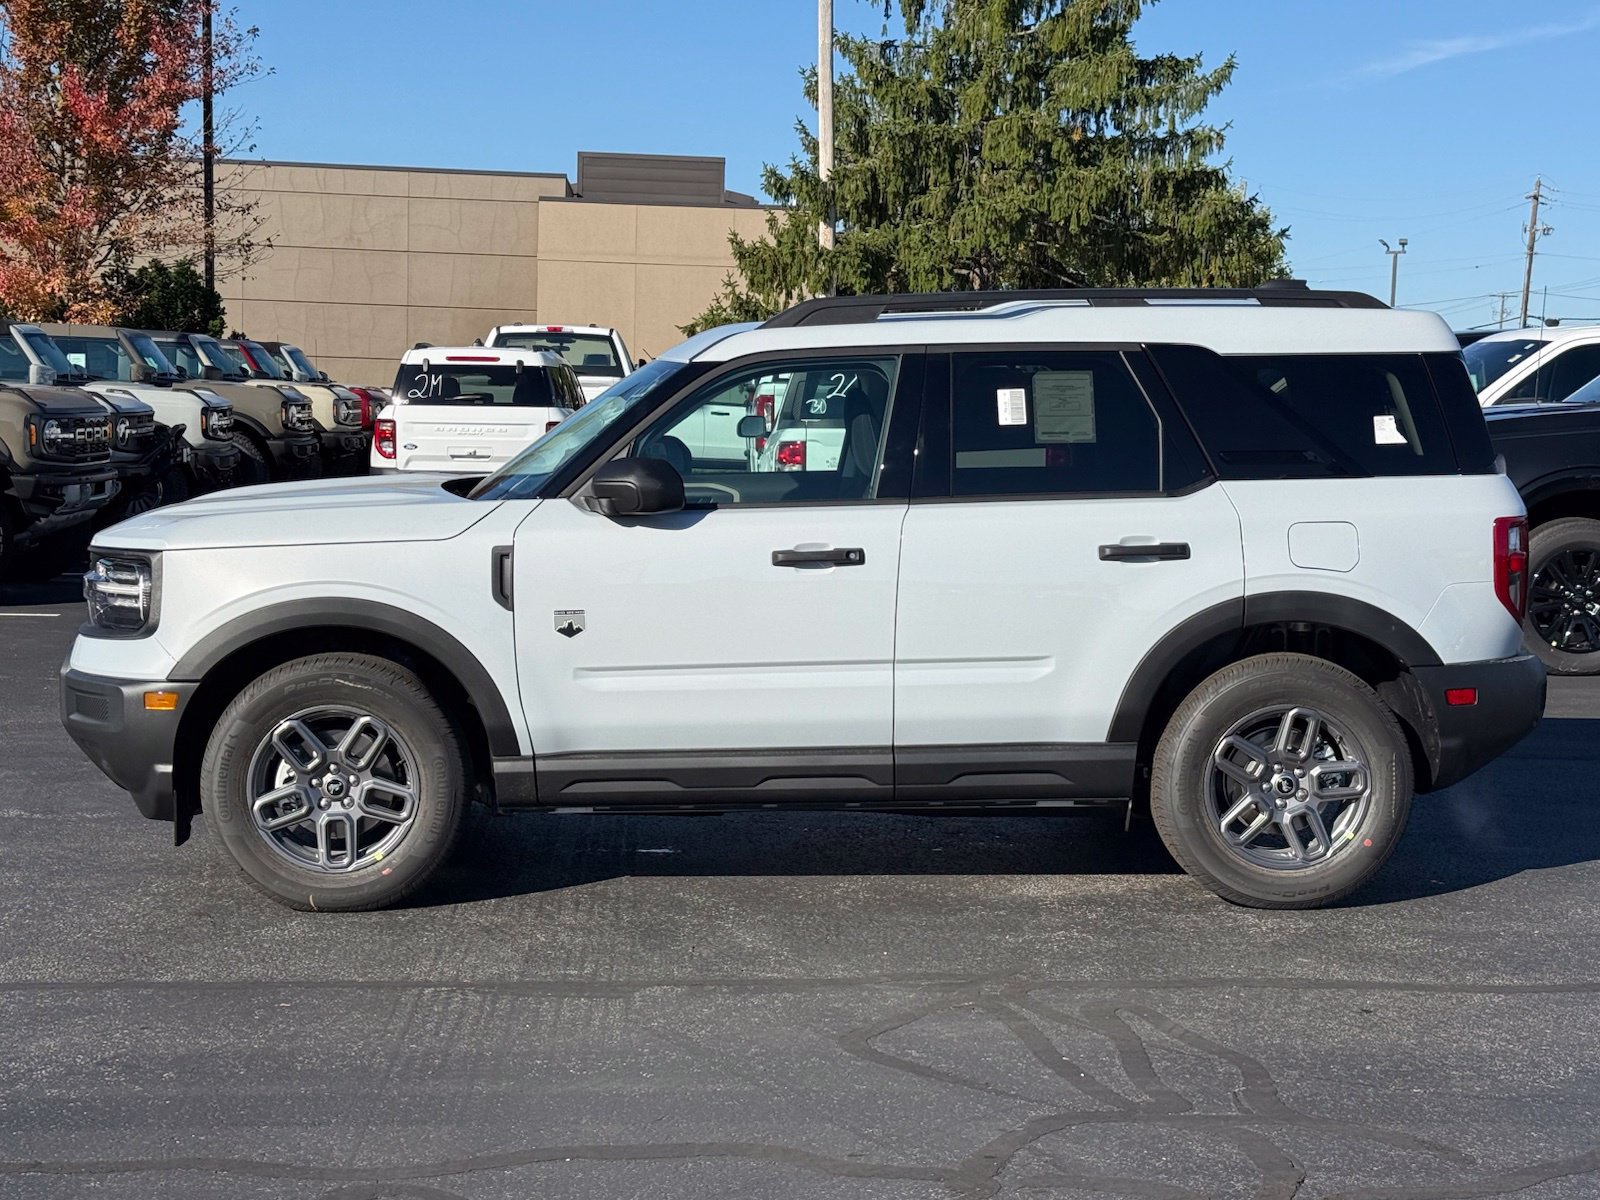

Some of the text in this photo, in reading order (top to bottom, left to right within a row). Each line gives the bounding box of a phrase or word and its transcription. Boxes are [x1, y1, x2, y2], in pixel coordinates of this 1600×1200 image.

[75, 426, 110, 442] FORD
[214, 742, 236, 824] Continental
[428, 755, 449, 836] Continental
